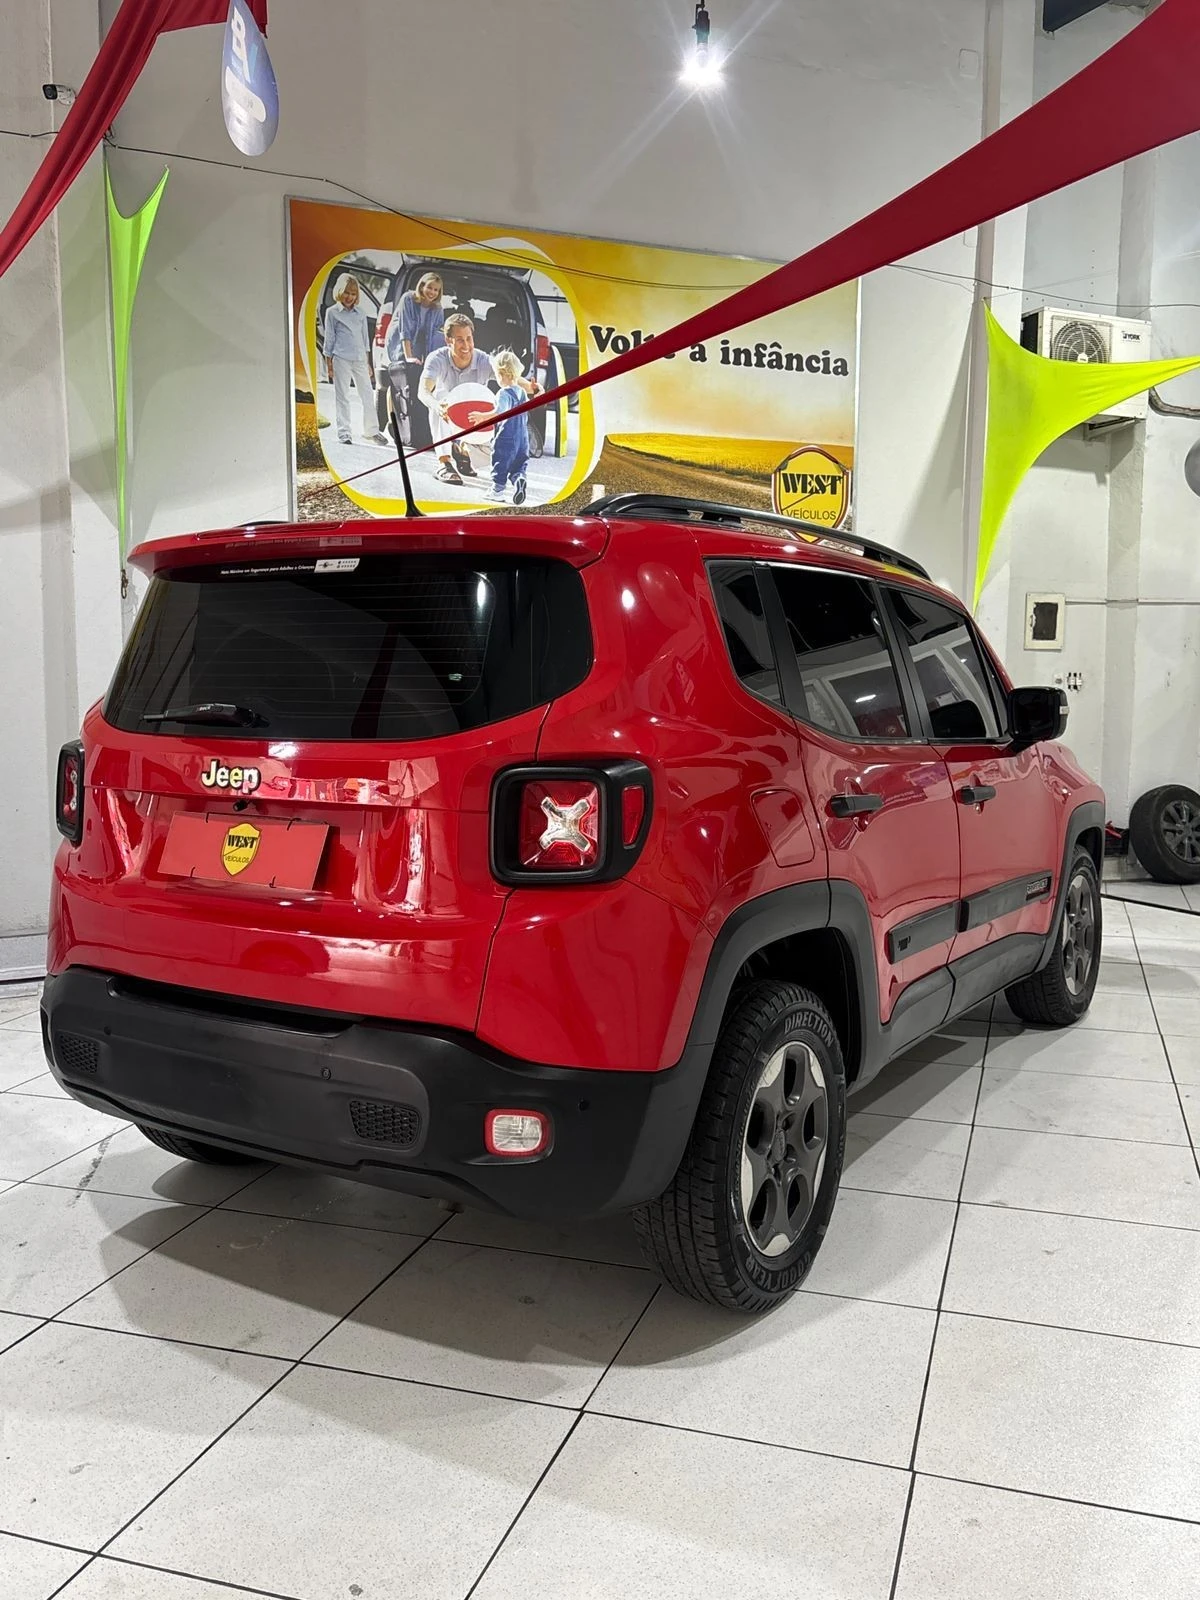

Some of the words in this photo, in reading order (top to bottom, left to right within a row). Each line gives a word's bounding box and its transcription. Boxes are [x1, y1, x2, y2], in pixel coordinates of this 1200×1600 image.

[589, 326, 676, 359] Vol
[689, 343, 707, 362] a
[719, 339, 849, 377] infância
[782, 473, 843, 495] WEST
[786, 508, 837, 520] VEÍCULOS
[201, 759, 262, 794] Jeep
[228, 835, 258, 848] WEST
[784, 1011, 834, 1048] DIRECTION
